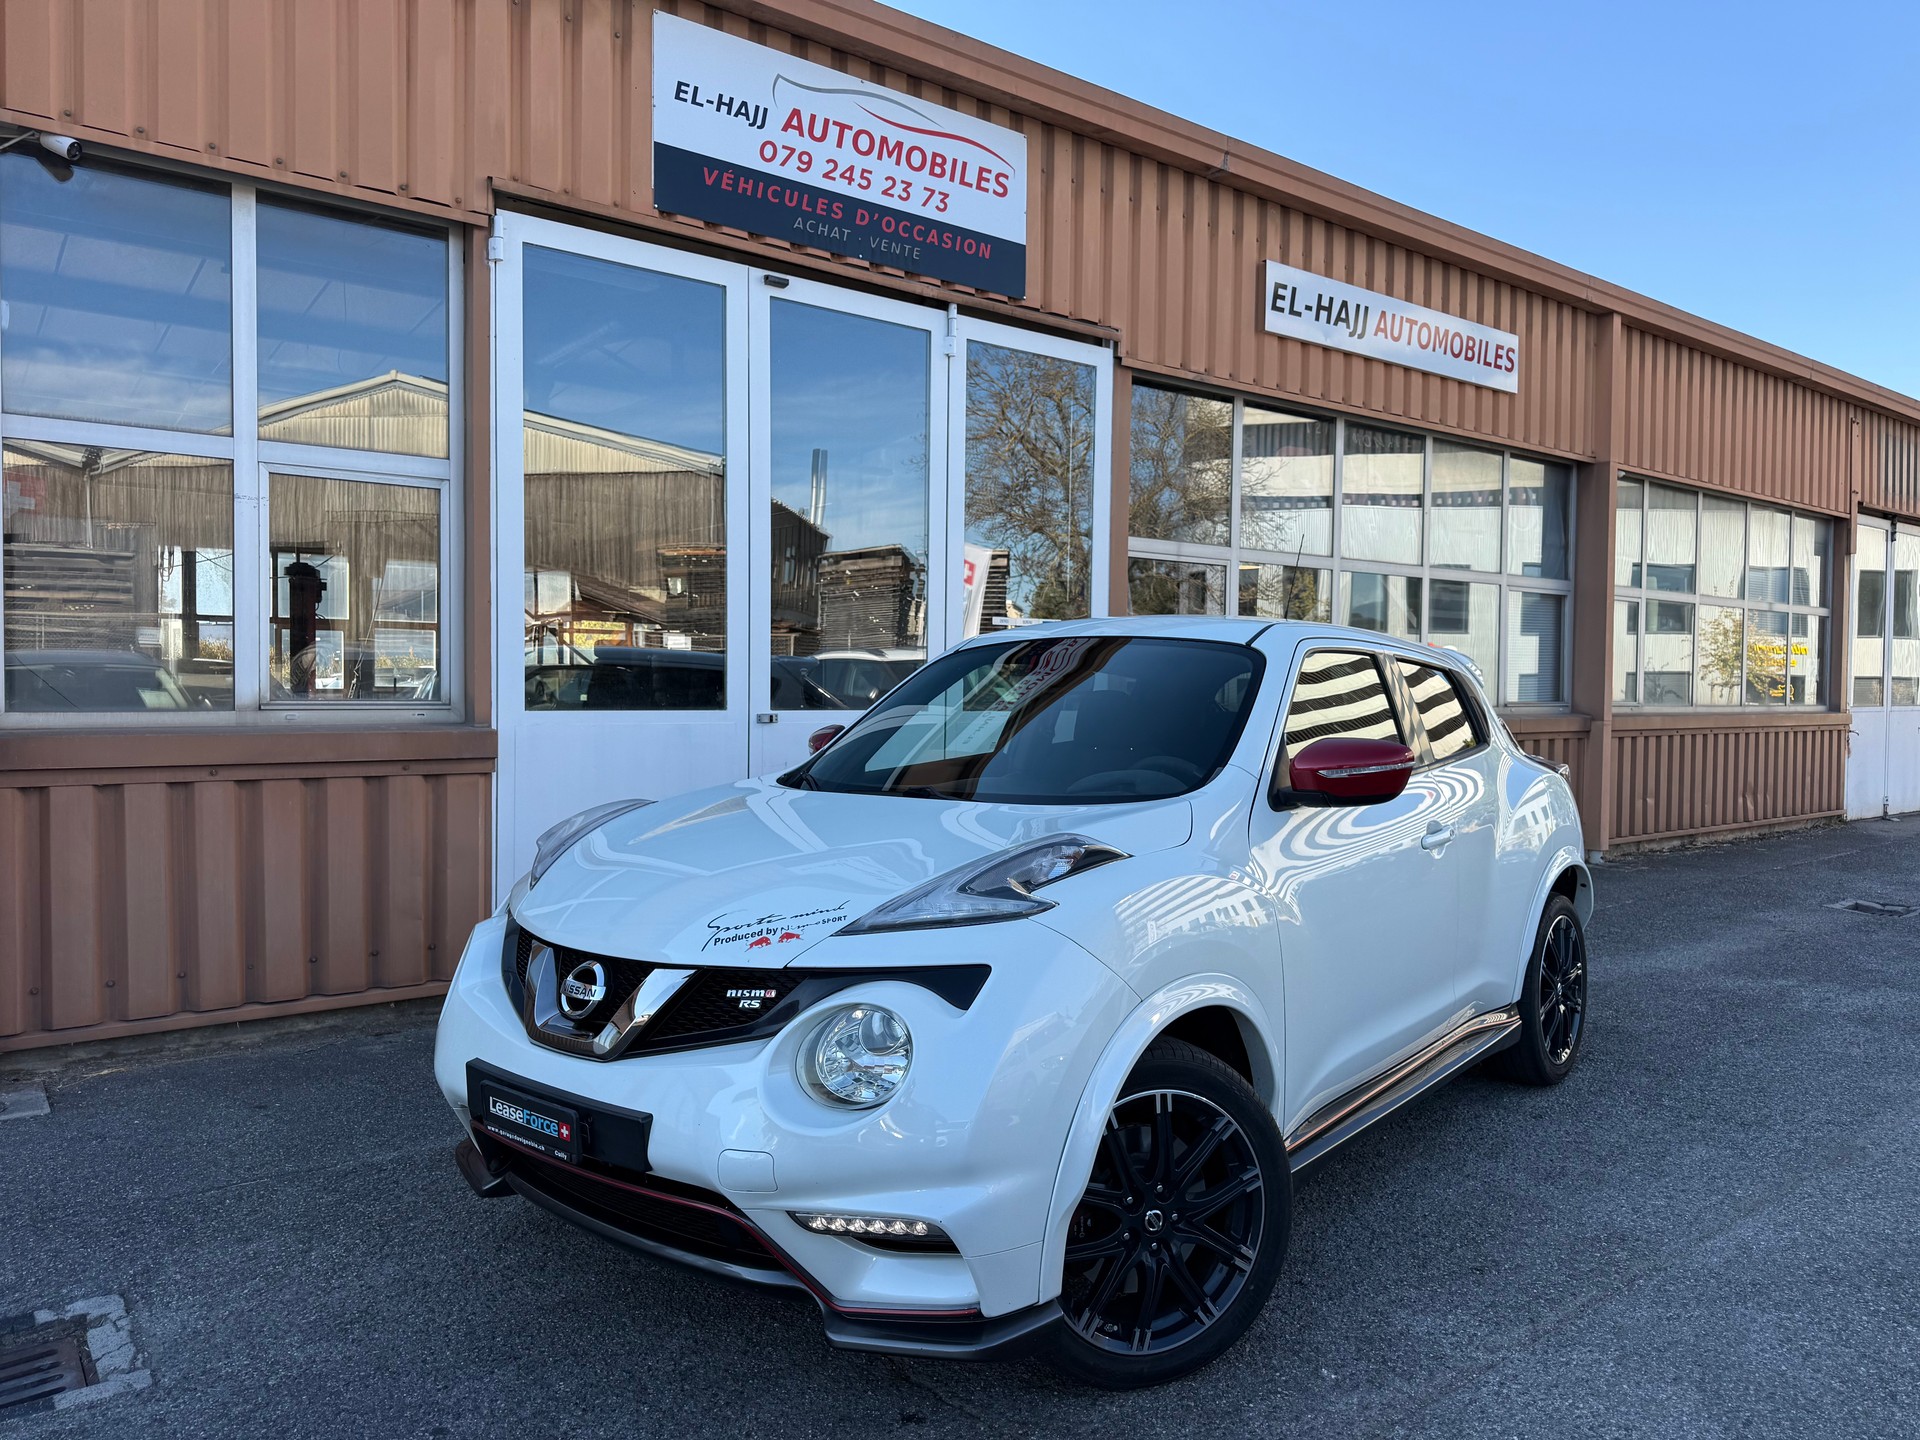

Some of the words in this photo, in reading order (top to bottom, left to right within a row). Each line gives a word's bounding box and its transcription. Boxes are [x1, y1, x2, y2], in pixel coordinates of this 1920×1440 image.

[674, 80, 769, 130] EL-HAJJ
[781, 107, 1010, 199] AUTOMOBILES
[759, 140, 813, 174] 079
[822, 158, 874, 191] 245
[881, 175, 912, 202] 23
[921, 187, 950, 213] 73
[703, 166, 844, 220] VÉHICULES
[855, 209, 992, 260] D'OCCASION
[793, 217, 852, 242] ACHAT
[870, 236, 921, 260] VENTE
[1271, 281, 1369, 340] EL-HAJJ
[1373, 310, 1516, 374] AUTOMOBILES
[713, 929, 763, 946] Produced
[766, 927, 779, 937] by
[821, 915, 848, 925] SPORT
[564, 982, 597, 998] NISSAN
[738, 1000, 761, 1008] RS
[489, 1096, 559, 1136] LeaseForce
